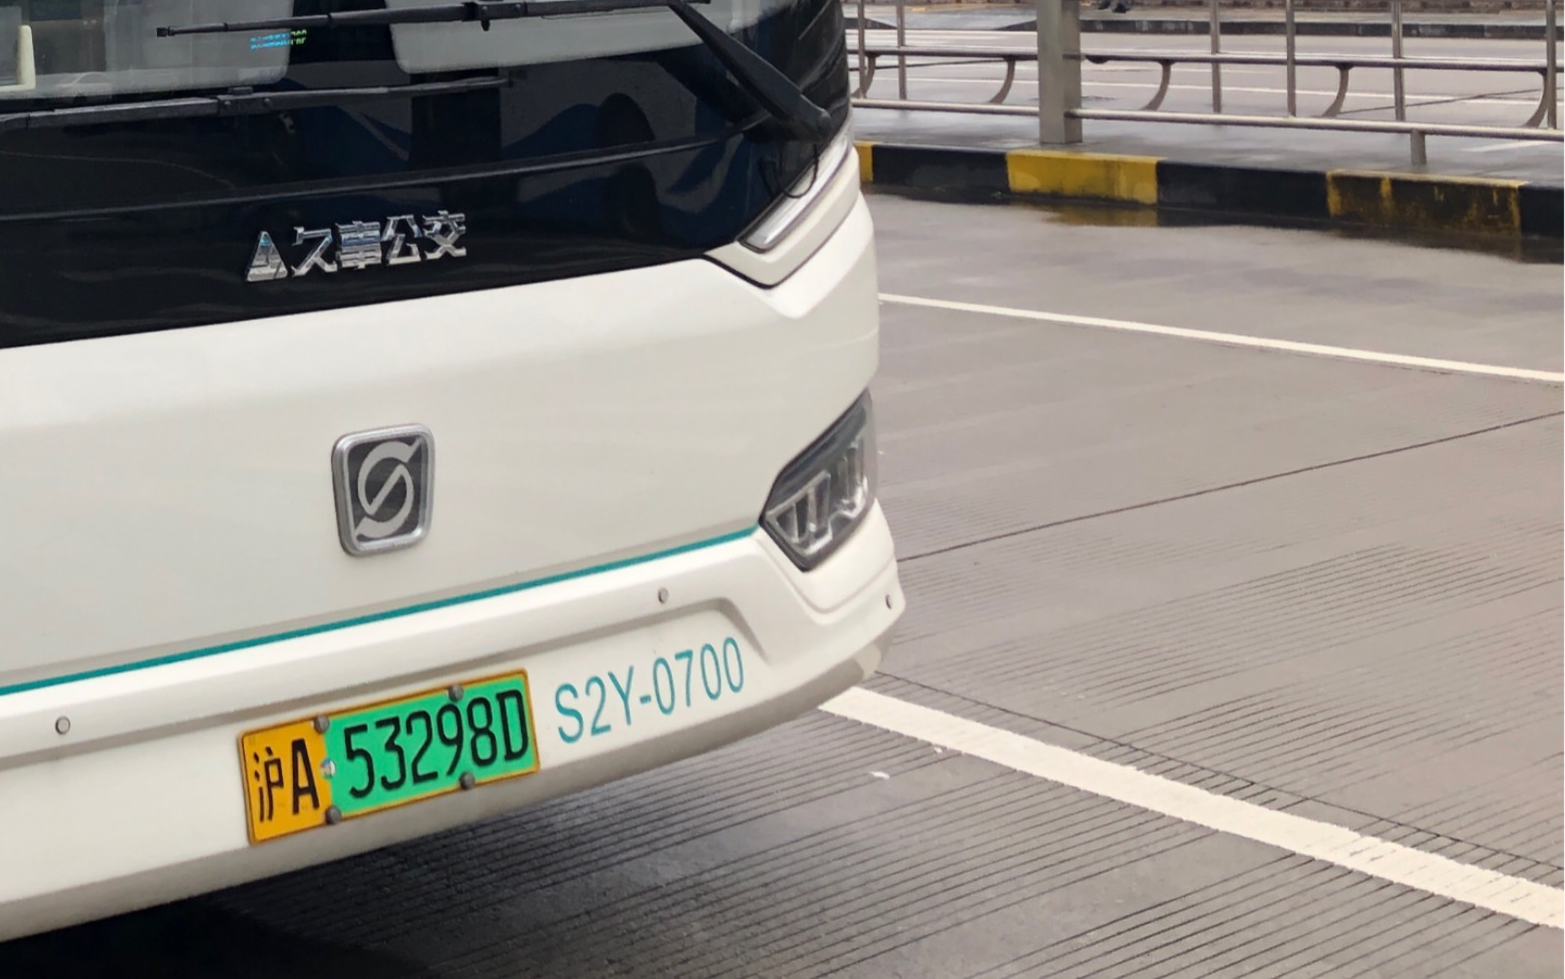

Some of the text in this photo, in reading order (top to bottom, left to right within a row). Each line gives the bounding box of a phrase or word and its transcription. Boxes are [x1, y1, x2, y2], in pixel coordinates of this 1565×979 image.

[291, 210, 467, 277] 久事公交
[342, 688, 531, 800] 53298D
[553, 636, 745, 744] S2Y-0700
